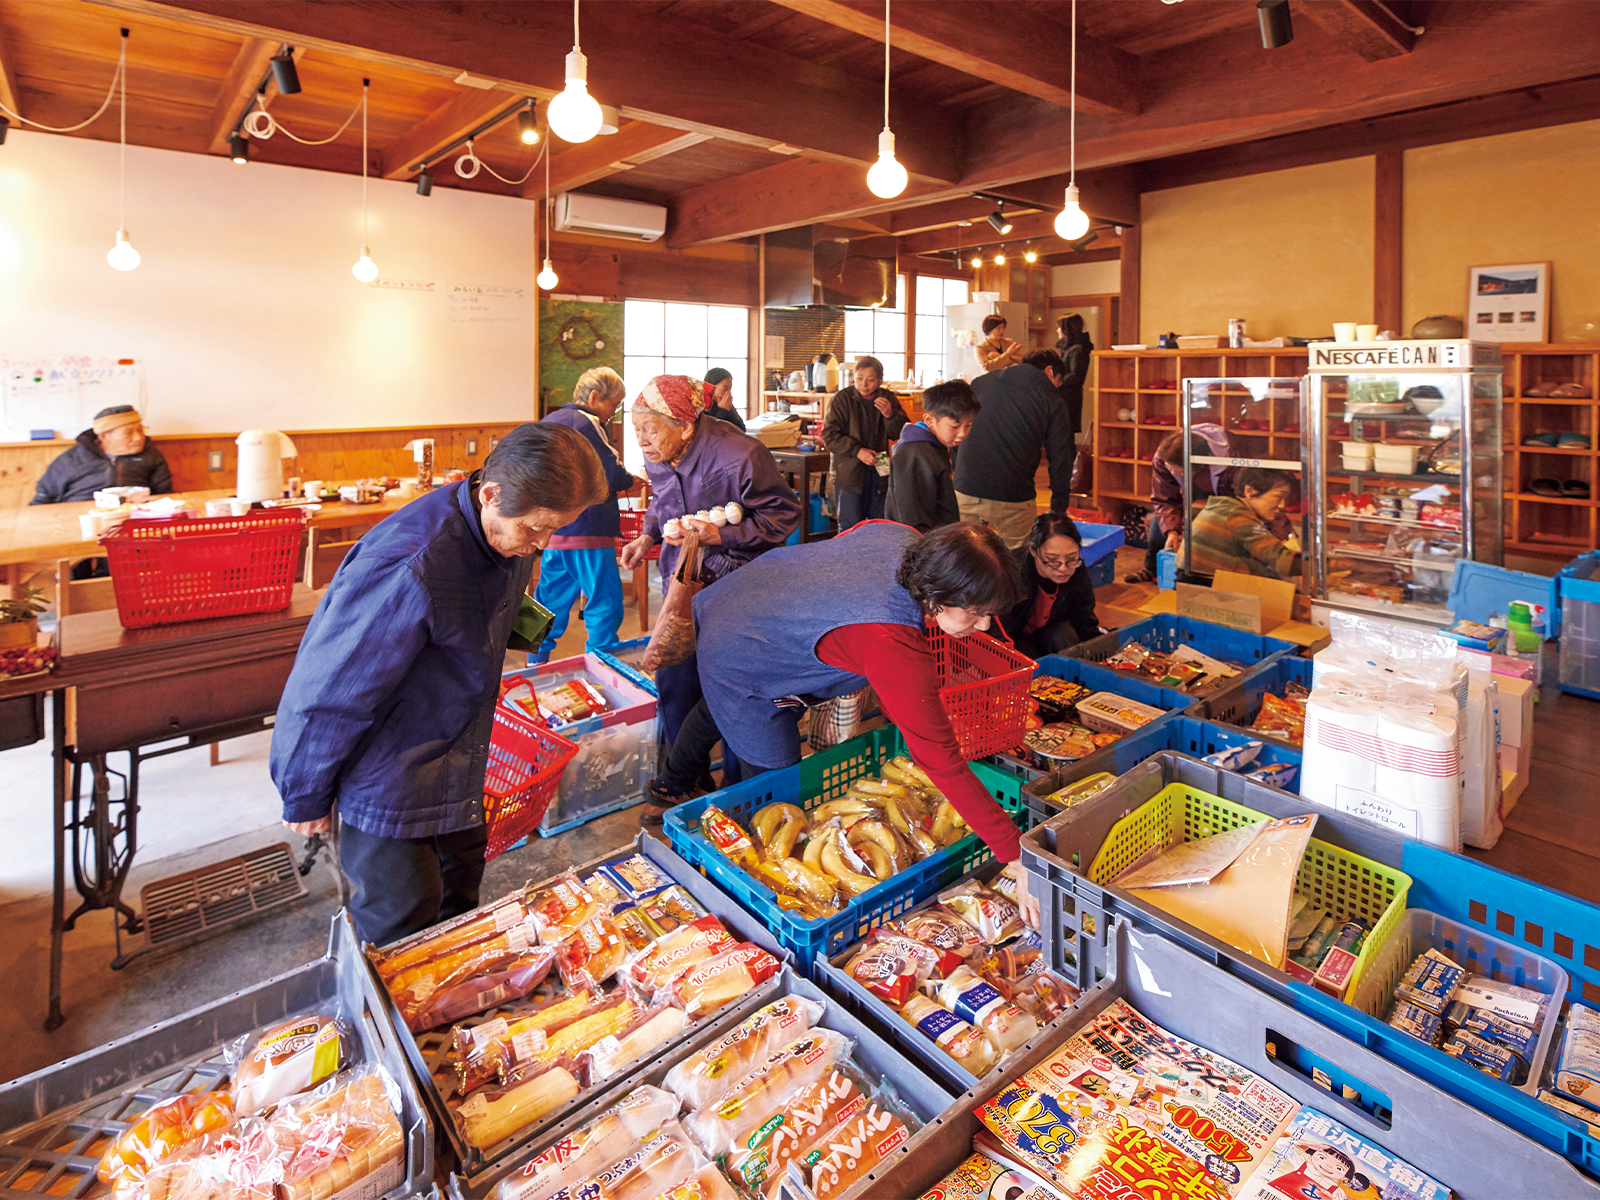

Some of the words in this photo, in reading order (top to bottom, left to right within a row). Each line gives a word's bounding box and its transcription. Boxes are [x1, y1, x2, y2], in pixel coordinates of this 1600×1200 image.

[1402, 346, 1437, 364] CAN
[1231, 459, 1260, 467] COLD
[1345, 804, 1406, 828] トイレットロール
[1360, 800, 1391, 815] ふんわり
[1081, 1028, 1137, 1069] 簡単!
[1100, 1020, 1155, 1060] 速い!!
[1117, 1013, 1226, 1088] スグできる!
[1031, 1070, 1061, 1094] CD-ROM
[771, 1074, 851, 1163] コッペパン
[838, 1101, 858, 1122] ヤマザキ
[1097, 1111, 1119, 1125] 2020
[663, 1142, 680, 1156] 5個入
[814, 1104, 889, 1192] コッペパン
[879, 1134, 900, 1154] ヤマザキ
[1159, 1129, 1202, 1161] 完成年賀状
[1165, 1121, 1210, 1154] イラスト素材
[1109, 1115, 1217, 1199] 年賀状
[1297, 1111, 1423, 1193] 浦沢直樹
